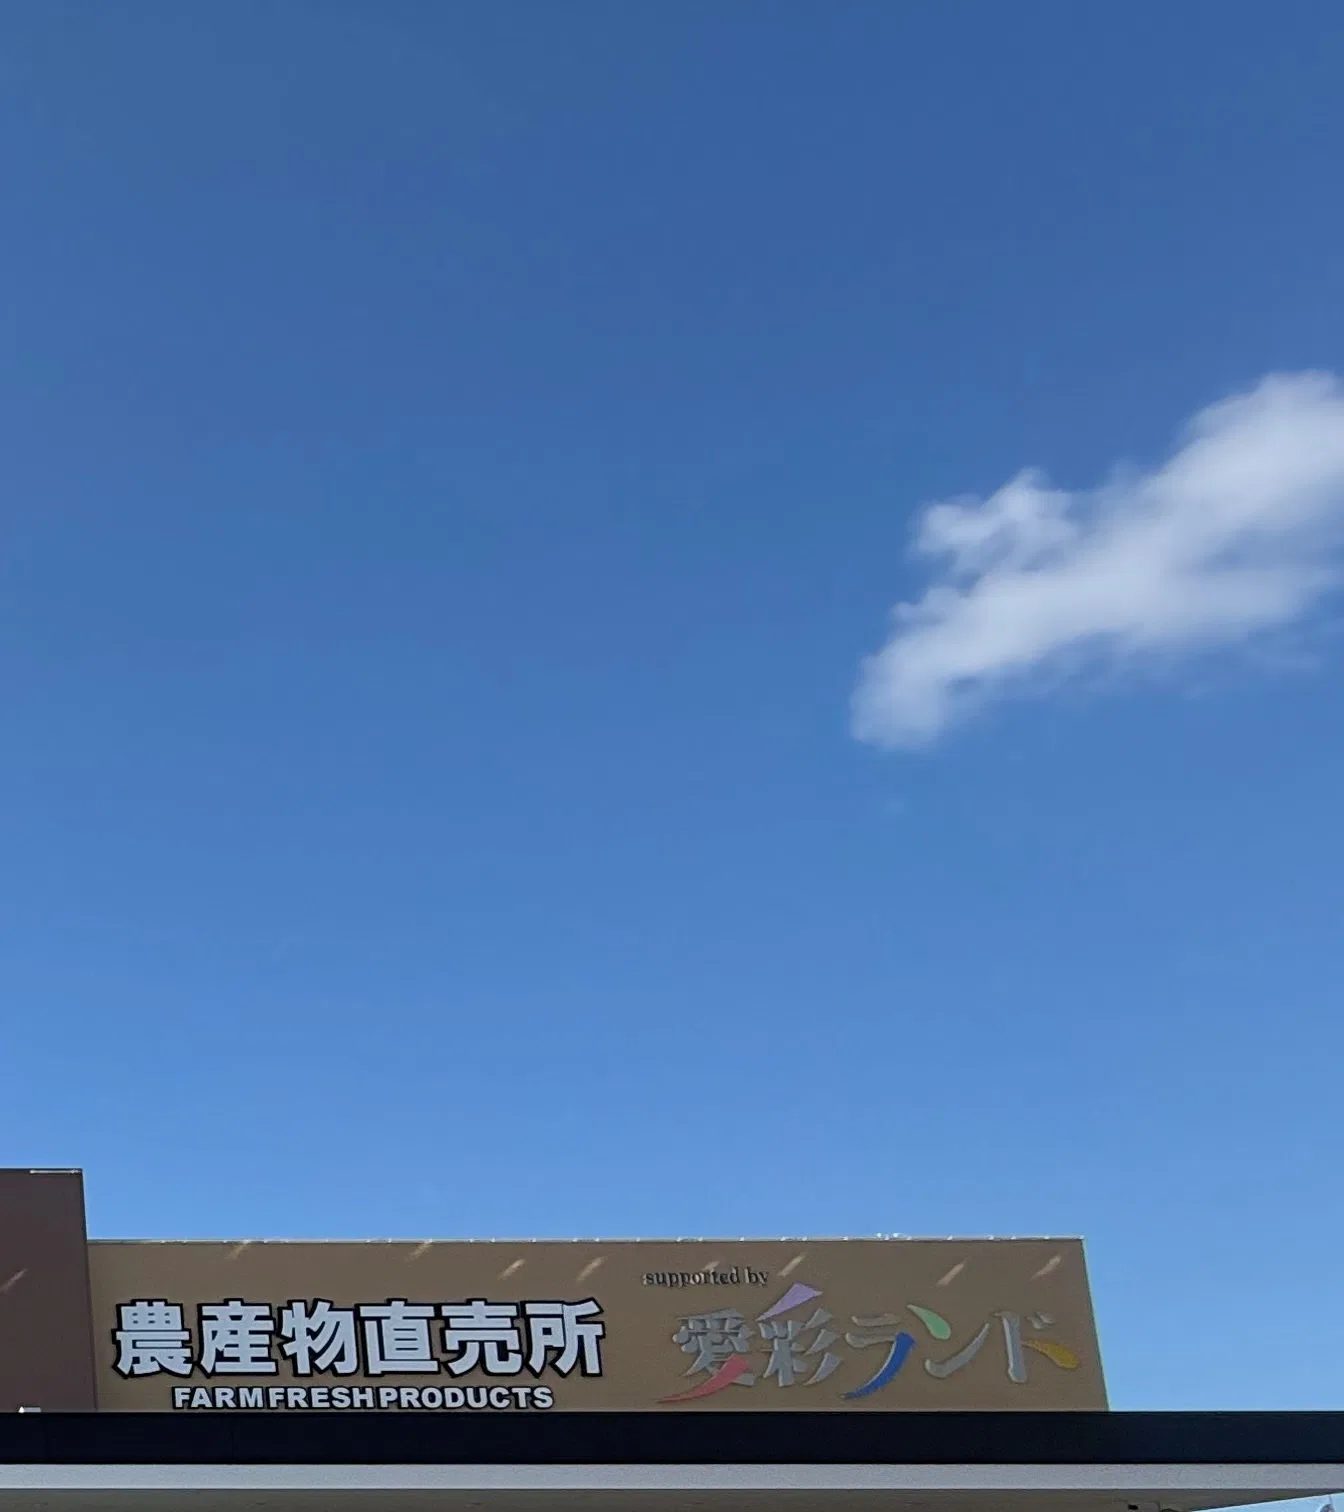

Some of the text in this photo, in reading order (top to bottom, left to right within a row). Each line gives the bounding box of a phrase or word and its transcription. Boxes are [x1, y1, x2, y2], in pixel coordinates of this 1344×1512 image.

[643, 1268, 769, 1287] supported by
[113, 1299, 605, 1377] 農産物直売所
[656, 1282, 1080, 1403] 愛彩ランド
[381, 1387, 554, 1409] PRODUCTS
